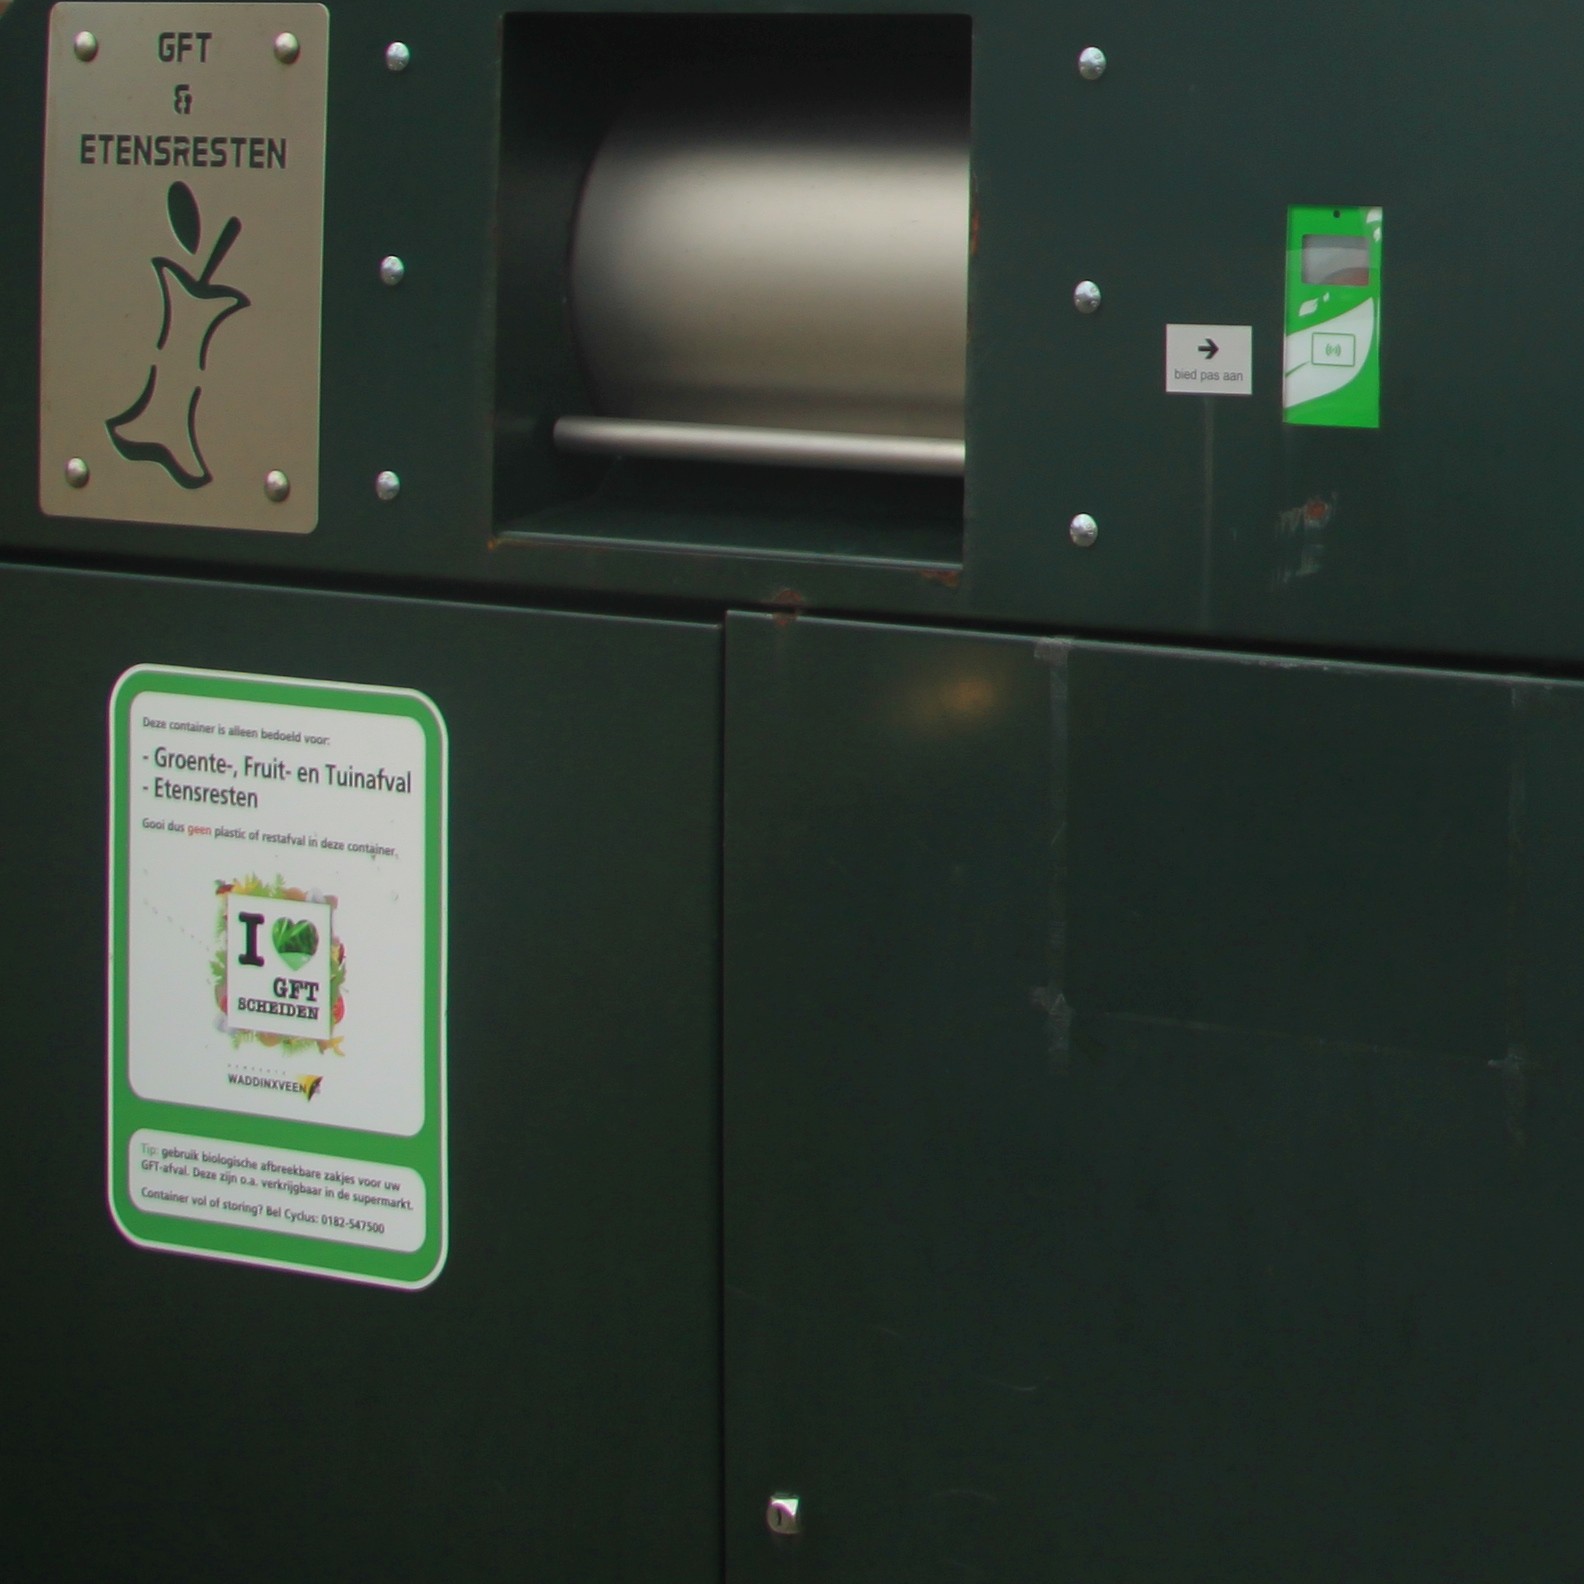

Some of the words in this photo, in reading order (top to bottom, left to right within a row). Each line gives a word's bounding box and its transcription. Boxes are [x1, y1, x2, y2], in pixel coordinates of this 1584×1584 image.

[158, 31, 212, 63] GFT
[79, 133, 287, 169] ETENSRESTEN
[1174, 368, 1197, 380] bied
[1200, 371, 1220, 383] pas
[1223, 371, 1243, 381] aan
[143, 716, 166, 729] Deze
[169, 720, 215, 734] container
[218, 723, 226, 735] is
[228, 725, 258, 738] alleen
[260, 728, 301, 742] bedoeld
[304, 736, 331, 745] voor:
[244, 755, 292, 781] Fruit-
[297, 765, 319, 784] en
[325, 763, 411, 794] Tuinafval
[154, 777, 258, 809] Etensresten
[142, 817, 166, 831] Gooi
[167, 821, 185, 833] dus
[187, 824, 212, 837] geen
[214, 824, 246, 840] plastic
[249, 829, 260, 841] of
[262, 831, 306, 846] restafval
[308, 835, 318, 848] in
[320, 837, 345, 851] deze
[238, 911, 265, 967] I
[273, 977, 319, 1002] GFT
[238, 997, 319, 1020] SCHEIDEN
[228, 1072, 307, 1094] WADDINXVEEN
[141, 1159, 190, 1176] GFT-afval.
[193, 1166, 217, 1180] Deze
[220, 1170, 238, 1185] zijn
[240, 1176, 258, 1186] o.a.
[261, 1179, 322, 1196] verkrijgbaar
[325, 1185, 335, 1198] in
[337, 1188, 350, 1200] de
[353, 1192, 413, 1211] supermarkt.
[161, 1147, 199, 1161] gebruik
[202, 1151, 258, 1169] biologische
[261, 1160, 321, 1179] afbreekbare
[324, 1171, 355, 1186] zakjes
[358, 1177, 382, 1188] voor
[384, 1181, 400, 1191] uw
[141, 1186, 189, 1203] Container
[191, 1195, 207, 1206] vol
[209, 1197, 221, 1207] of
[223, 1199, 263, 1216] storing?
[266, 1205, 282, 1217] Bel
[284, 1208, 319, 1223] Cyclus:
[321, 1214, 386, 1234] 0182-547500
